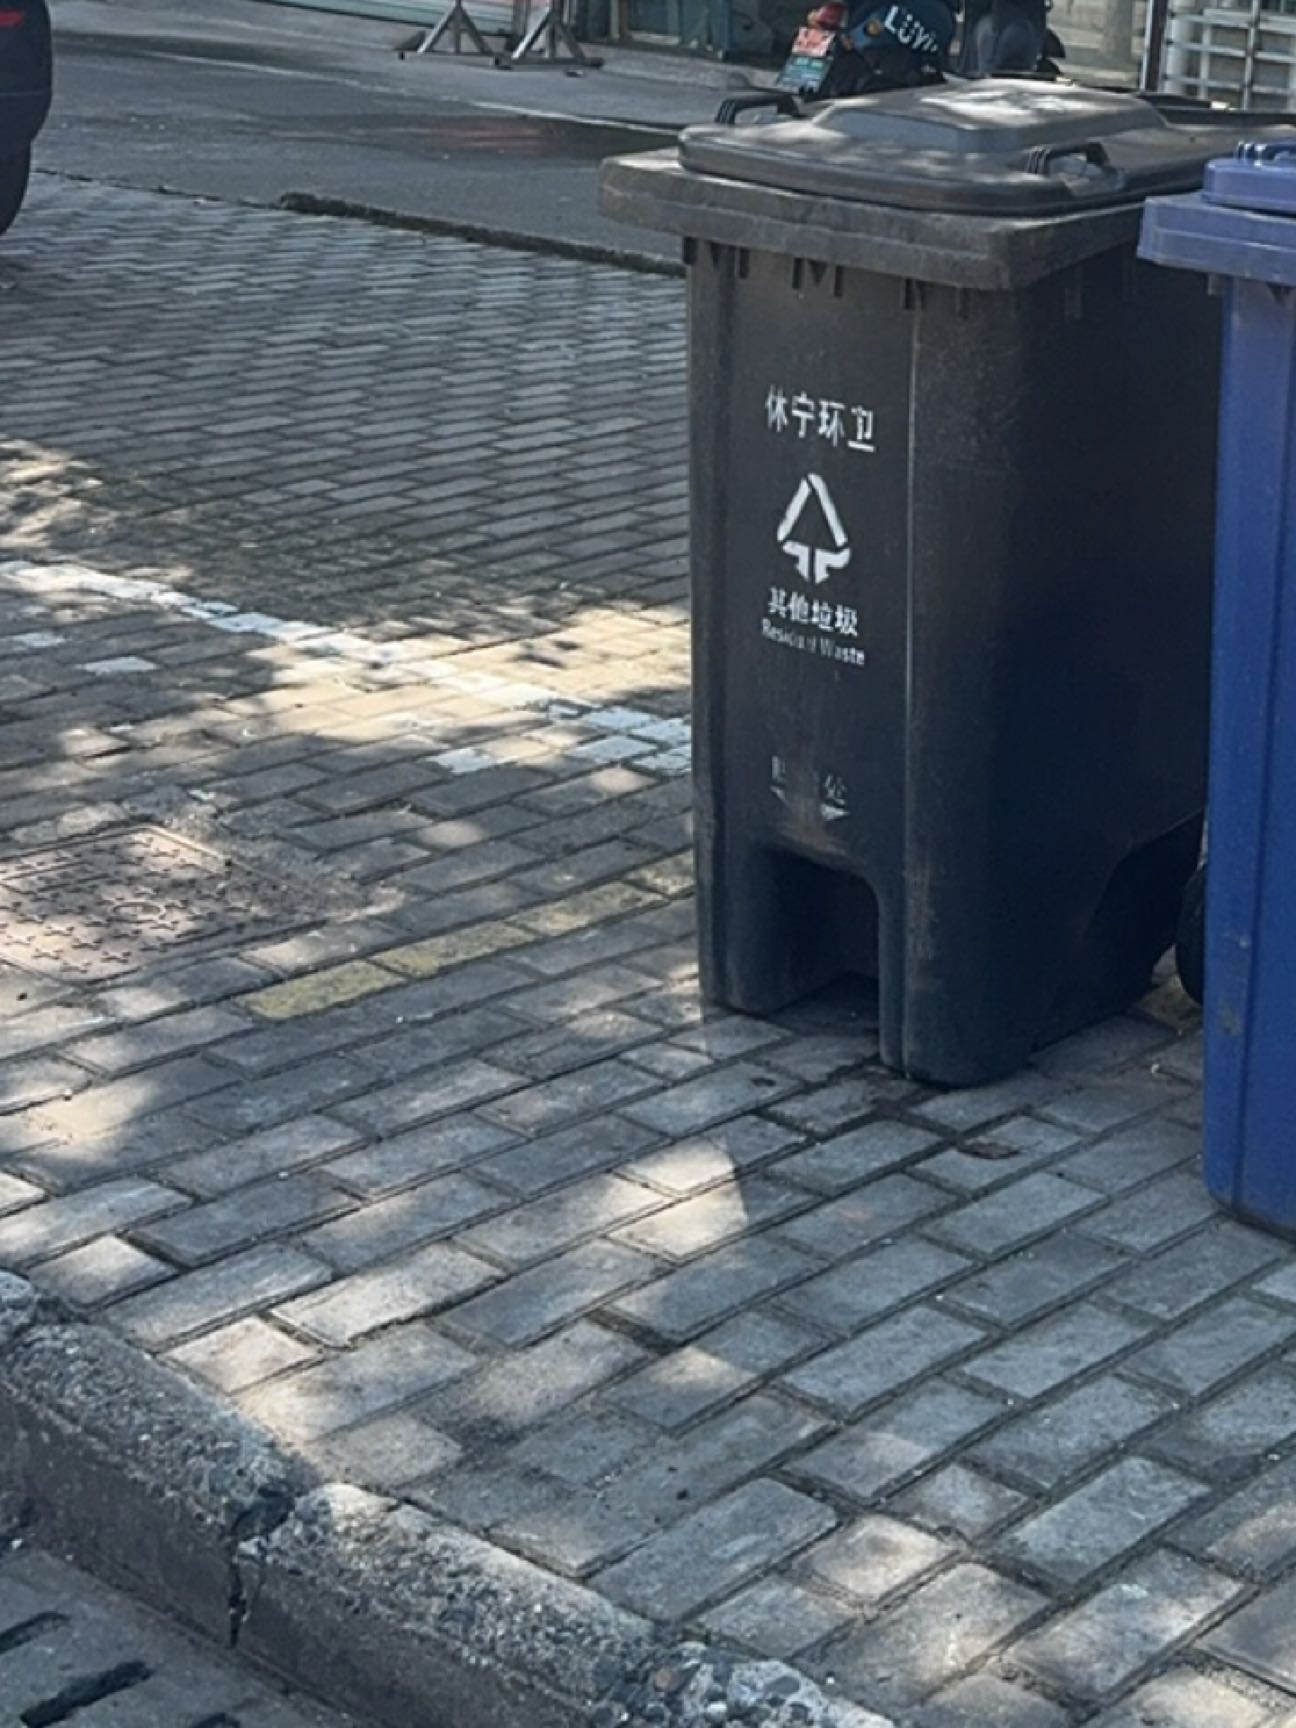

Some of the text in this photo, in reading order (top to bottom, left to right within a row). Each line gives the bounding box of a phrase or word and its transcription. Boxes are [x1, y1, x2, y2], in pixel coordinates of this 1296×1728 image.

[764, 384, 876, 453] 休宁环卫
[767, 587, 859, 637] 其他垃圾
